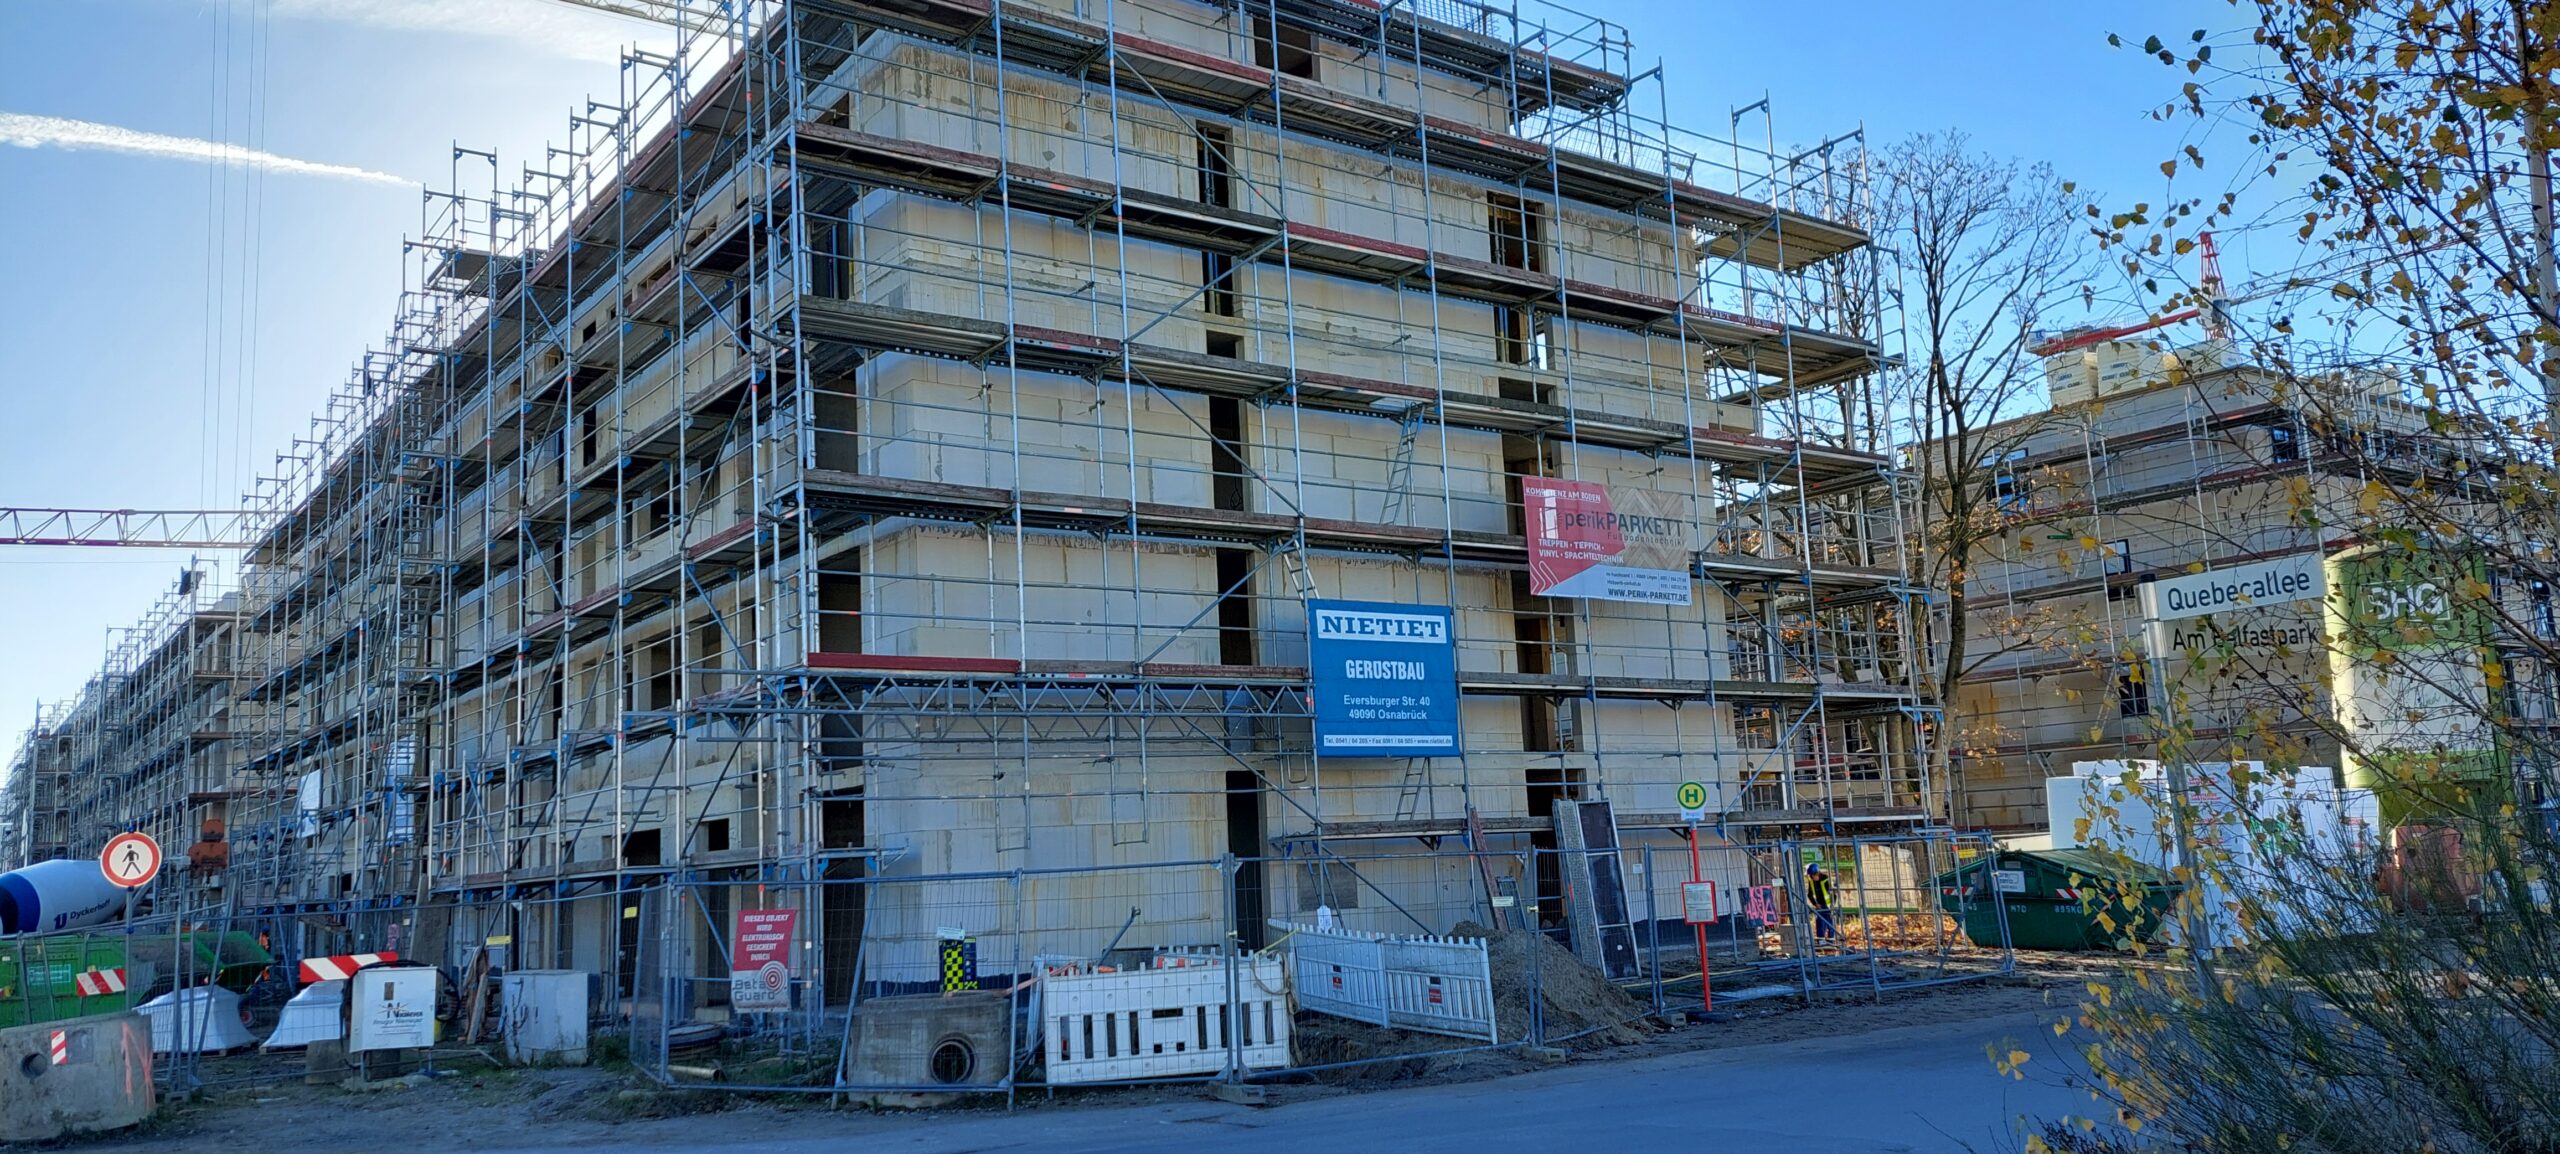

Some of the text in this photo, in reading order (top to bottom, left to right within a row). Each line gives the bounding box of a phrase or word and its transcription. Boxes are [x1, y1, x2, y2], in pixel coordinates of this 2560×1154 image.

[1690, 305, 1731, 321] NIETIET
[1568, 491, 1579, 499] AM
[1581, 492, 1601, 503] BODEN
[1565, 511, 1683, 537] perikPARKETT
[1538, 538, 1601, 550] TREPPEN TEPPICH
[1538, 549, 1624, 563] VINYL SPACHTELTECHNIK
[1607, 588, 1688, 602] WWW.PERIK-PARKETT.DE
[2167, 571, 2311, 612] Quebecallee
[1321, 615, 1441, 638] NIETIET
[2172, 622, 2320, 651] Am lfastpark
[1345, 659, 1425, 681] GERÜSTBAU
[1343, 694, 1431, 709] Eversburger Str. 40
[1349, 709, 1427, 720] 49090 Osnabrück
[1685, 788, 1699, 803] H
[70, 898, 111, 920] Dyckerhoff
[766, 914, 789, 922] OBJEKT
[734, 978, 767, 990] Beta
[734, 990, 775, 1001] Guard
